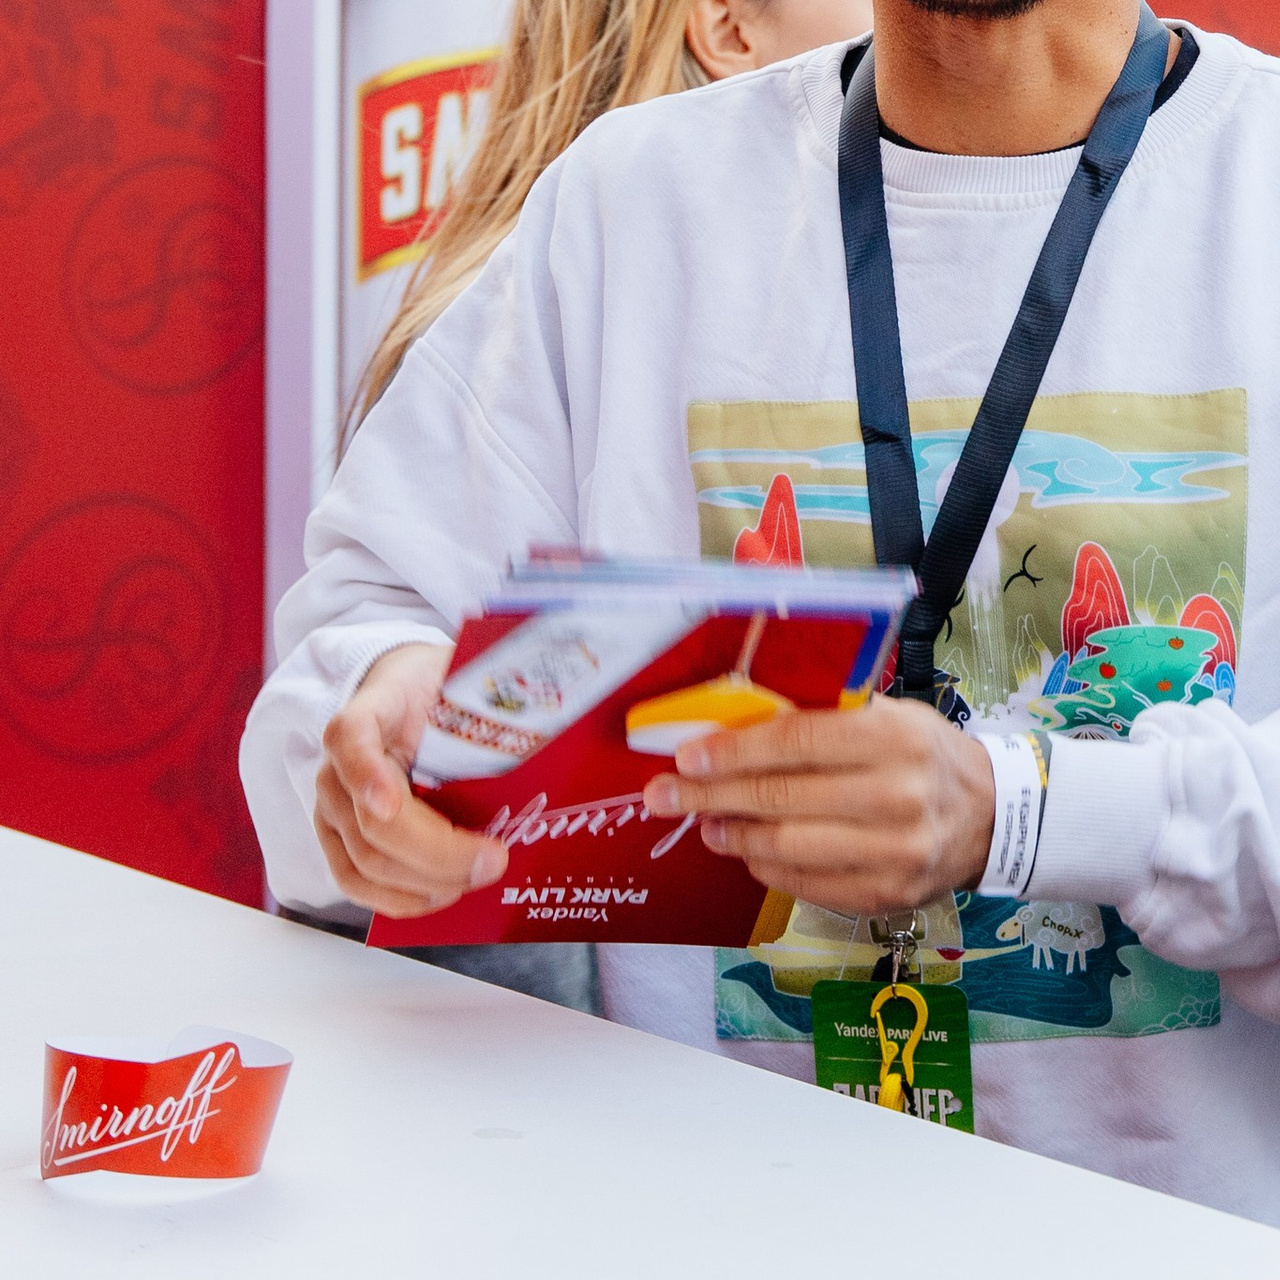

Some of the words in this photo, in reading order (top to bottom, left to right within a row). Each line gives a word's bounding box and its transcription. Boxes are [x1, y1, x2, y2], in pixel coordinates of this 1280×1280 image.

[501, 887, 566, 905] LIVE
[569, 887, 649, 904] PARK
[526, 907, 609, 922] Yandex
[887, 1028, 914, 1040] PAR
[922, 1030, 948, 1043] LIVE
[43, 1047, 239, 1169] Smirnoff
